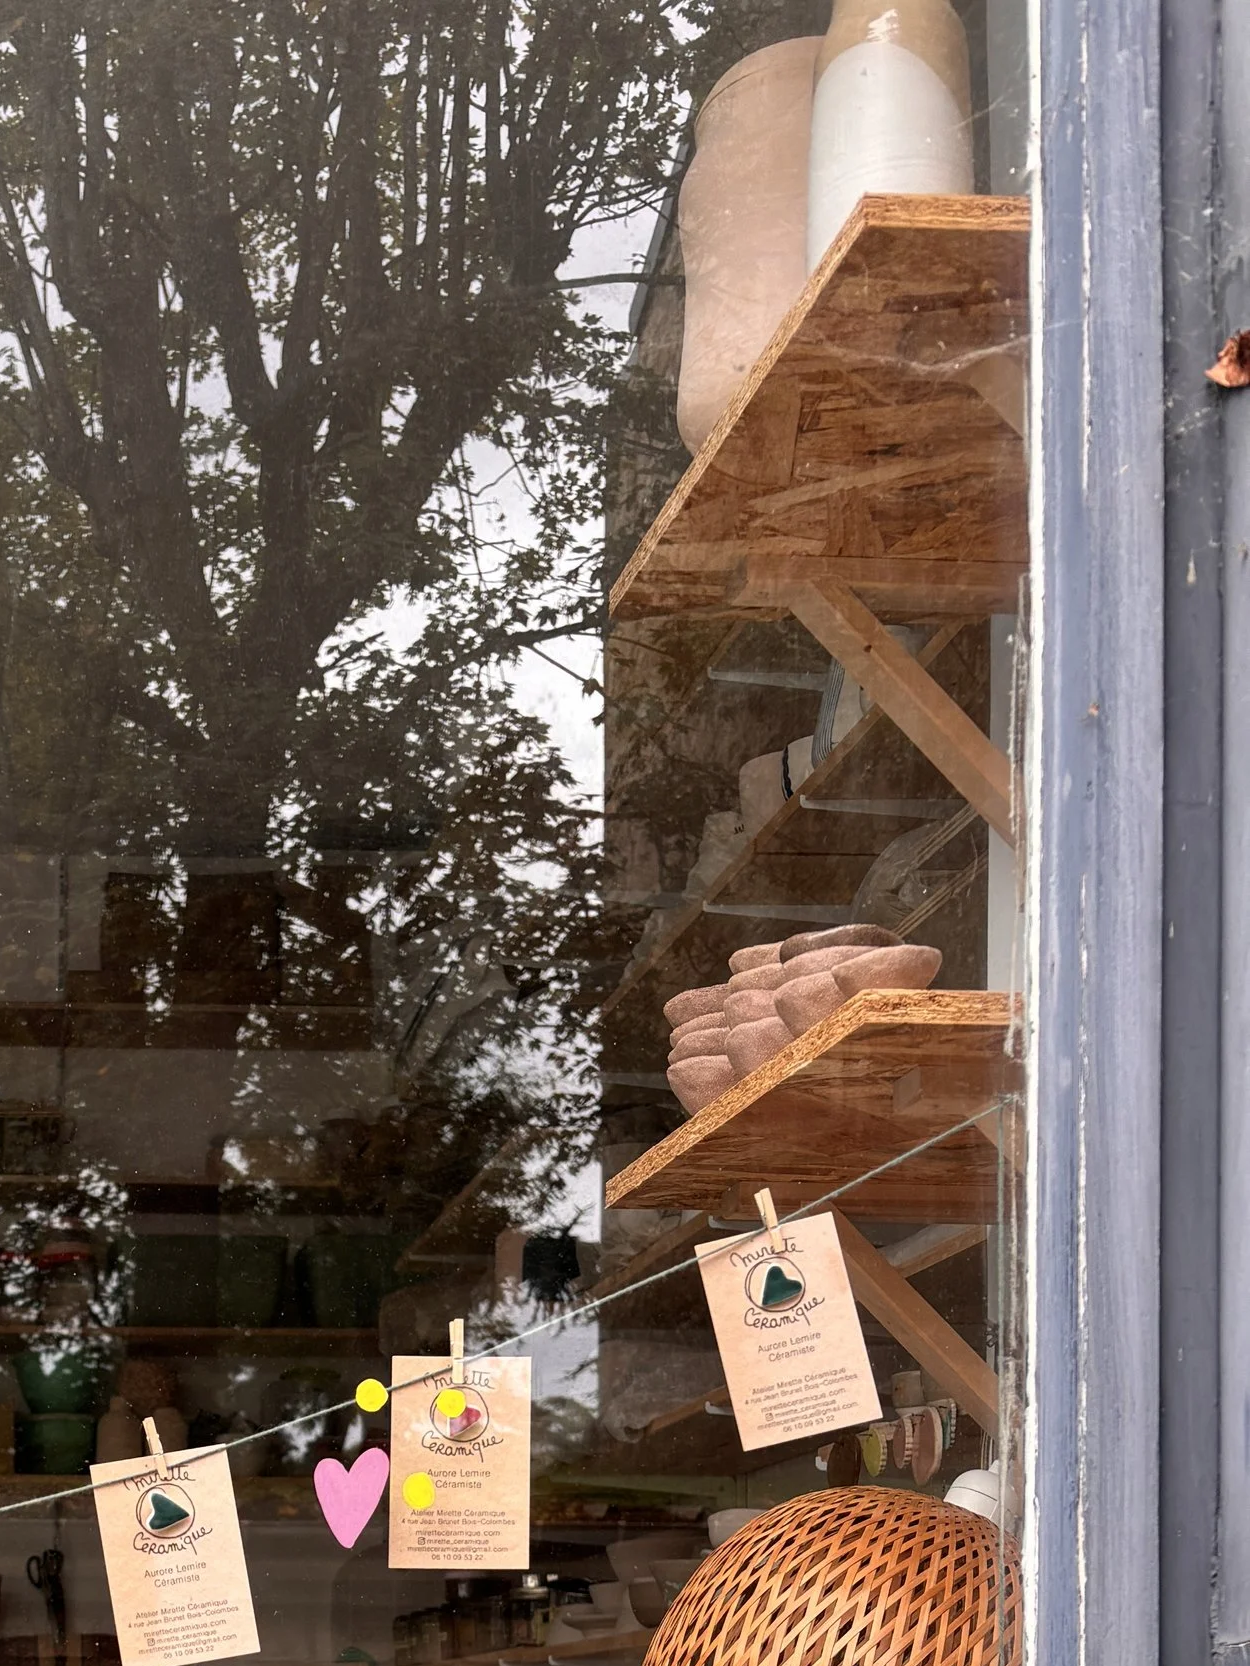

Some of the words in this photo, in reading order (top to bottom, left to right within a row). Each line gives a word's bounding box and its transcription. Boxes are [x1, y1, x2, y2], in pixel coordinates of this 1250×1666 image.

[426, 1468, 457, 1477] Aurore
[459, 1468, 491, 1477] Lemire
[435, 1479, 482, 1488] Céramiste
